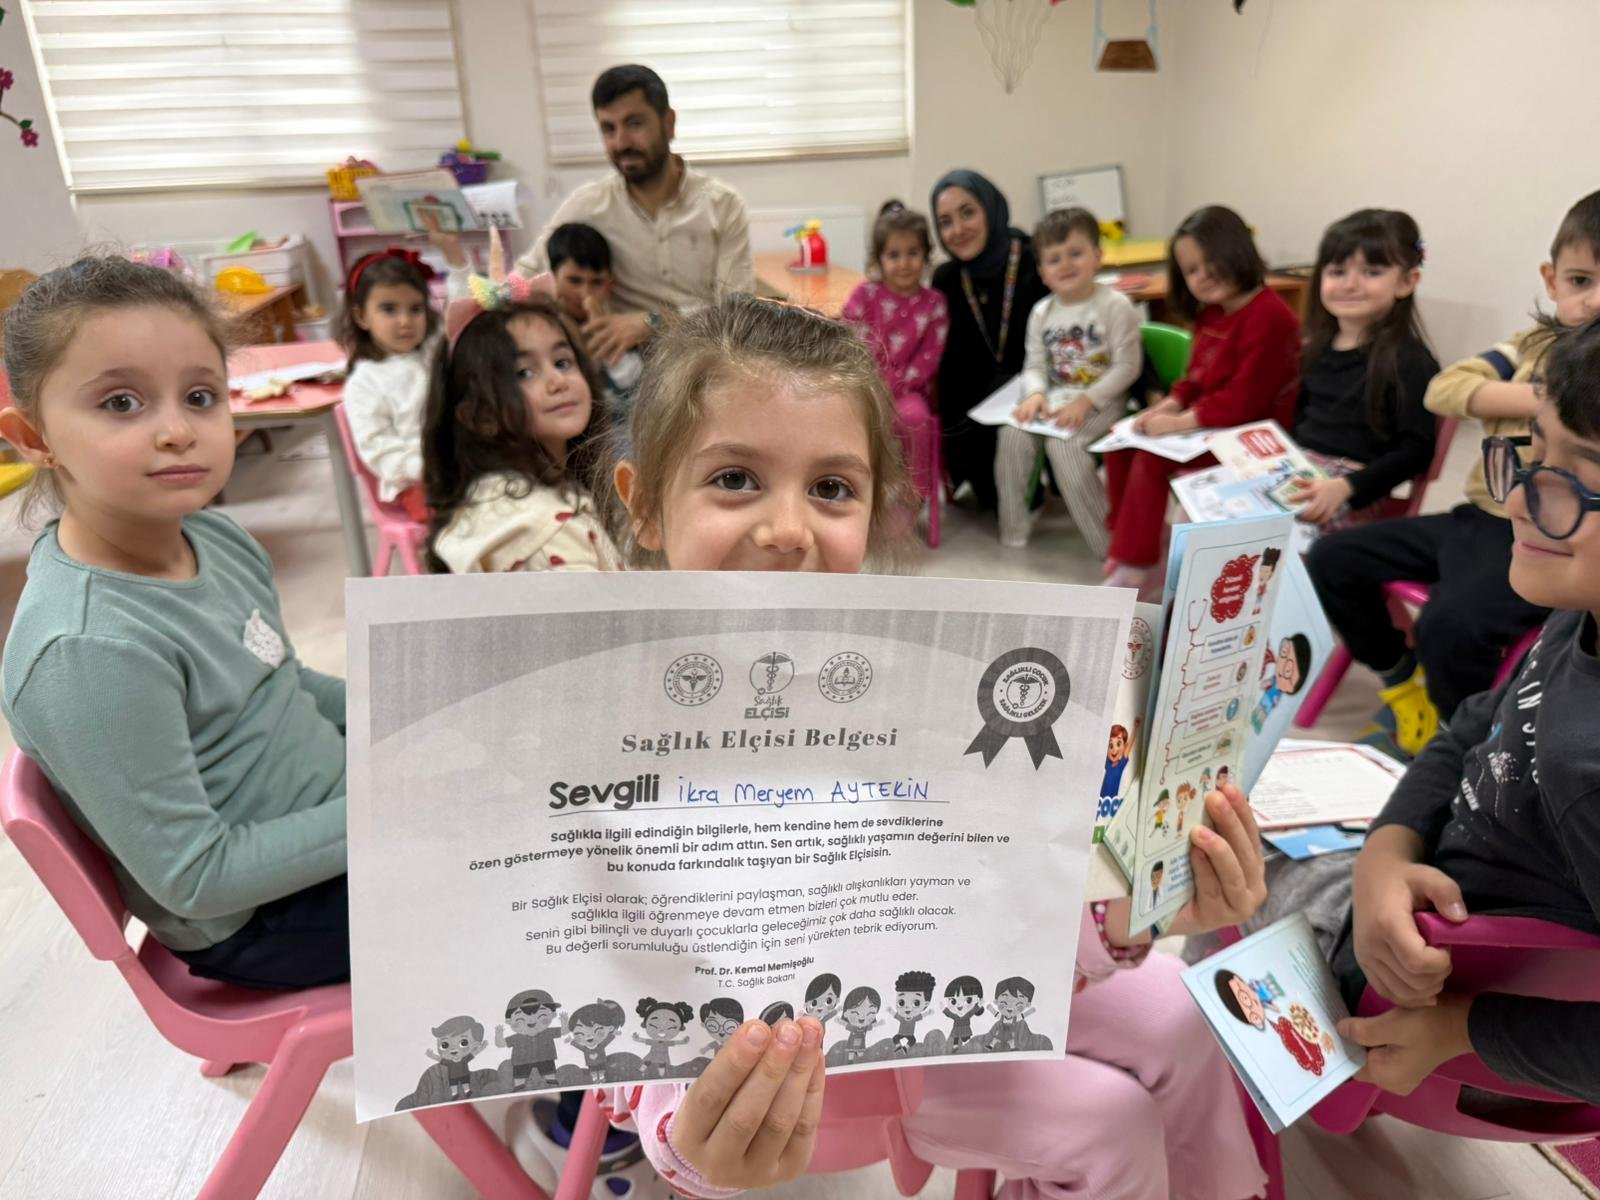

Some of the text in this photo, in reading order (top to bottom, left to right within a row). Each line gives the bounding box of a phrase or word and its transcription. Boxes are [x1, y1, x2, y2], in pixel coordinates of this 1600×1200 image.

[621, 728, 898, 756] Sağlık Elçisi Belgesi
[549, 774, 660, 810] Sevgili
[734, 783, 814, 808] Meryem
[551, 816, 943, 843] sağlıkla ilgili edindiğin bilgilerle, hem kendine hem de sevdiklerine
[469, 832, 1010, 870] özen göstermeye yönelik önemli bir adım attın. Sen artık, sağlıklı yaşamın değerini bilen ve
[608, 848, 892, 872] bu konuda farkındalık taşıyan bir Sağlık Elçisisin.
[512, 878, 970, 912] Bir Sağlık Elçisi olarak; öğrendiklerini paylaşman, sağlıklı alışkanlıkları yayman ve
[571, 891, 919, 923] sağlıkla ilgili öğrenmeye devam etmen bizleri çok mutlu eder.
[526, 906, 956, 940] Senin gibi bilinçli ve duyarlı çocuklarla geleceğimiz çok daha sağlıklı olacak.
[546, 922, 938, 955] Bu değerli sorumluluğu üstlendiğin için seni yürekten tebrik ediyorum.
[695, 966, 716, 975] Prof.
[735, 964, 766, 974] Kemal
[768, 956, 814, 971] Memişoğlu
[718, 974, 795, 988] T.C. Sağlık Bakanı
